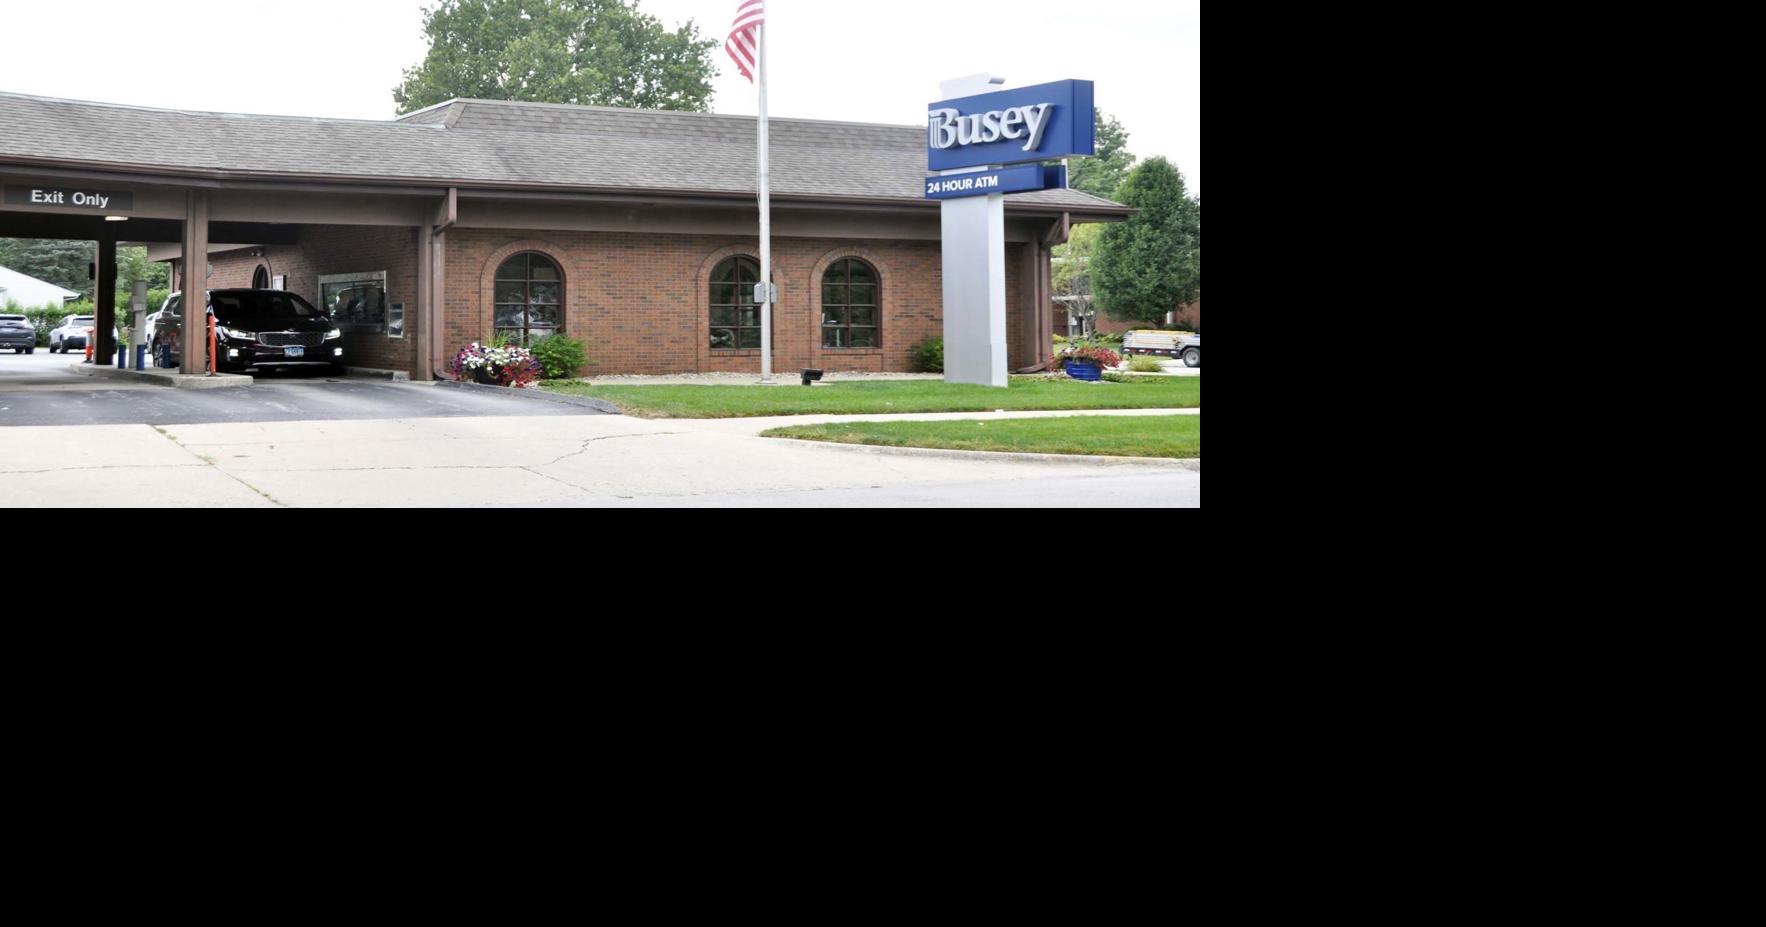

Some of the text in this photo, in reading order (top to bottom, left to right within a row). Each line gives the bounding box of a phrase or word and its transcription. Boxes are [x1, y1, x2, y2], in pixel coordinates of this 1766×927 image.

[928, 103, 1054, 151] Busey
[927, 175, 998, 193] 24 HOUR ATM
[31, 189, 109, 208] Exit Only
